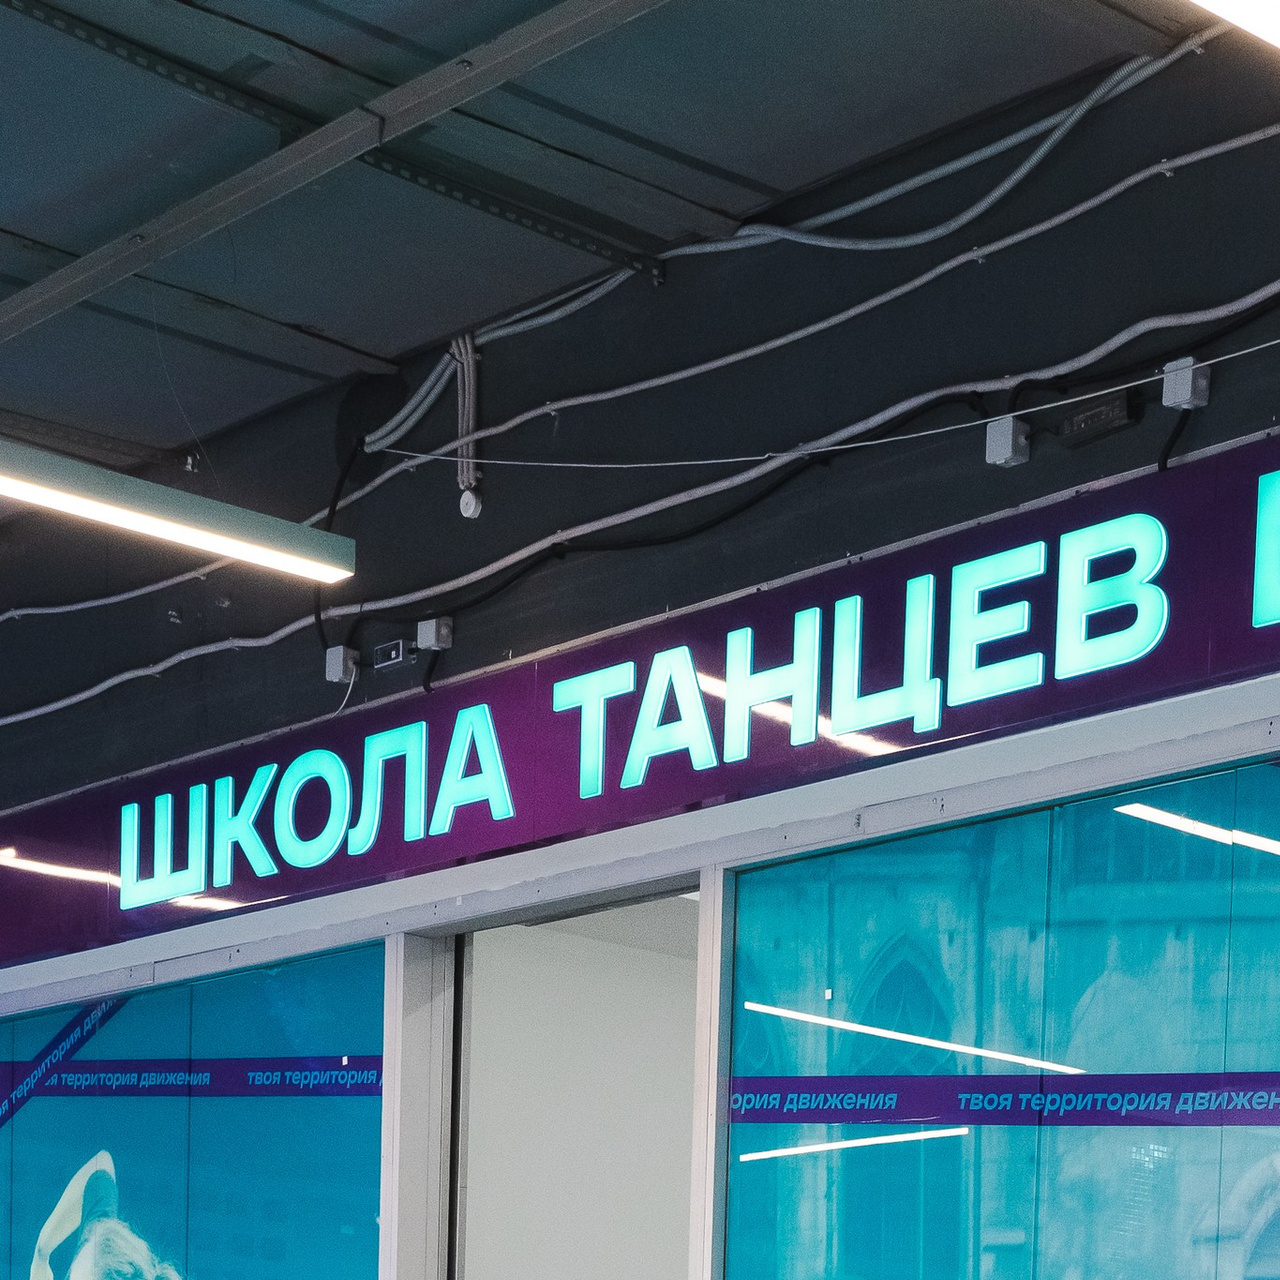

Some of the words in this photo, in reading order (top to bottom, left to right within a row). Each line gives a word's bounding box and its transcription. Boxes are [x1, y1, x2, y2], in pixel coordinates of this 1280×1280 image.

[119, 703, 516, 911] ШКОЛА
[552, 512, 1170, 799] ТАНЦЕВ
[10, 1025, 81, 1104] территория
[61, 1073, 138, 1089] территория
[139, 1071, 210, 1088] движения
[247, 1071, 281, 1085] твоя
[284, 1070, 377, 1089] территория
[783, 1092, 897, 1113] движения
[958, 1093, 1013, 1110] твоя
[1018, 1092, 1171, 1116] территория
